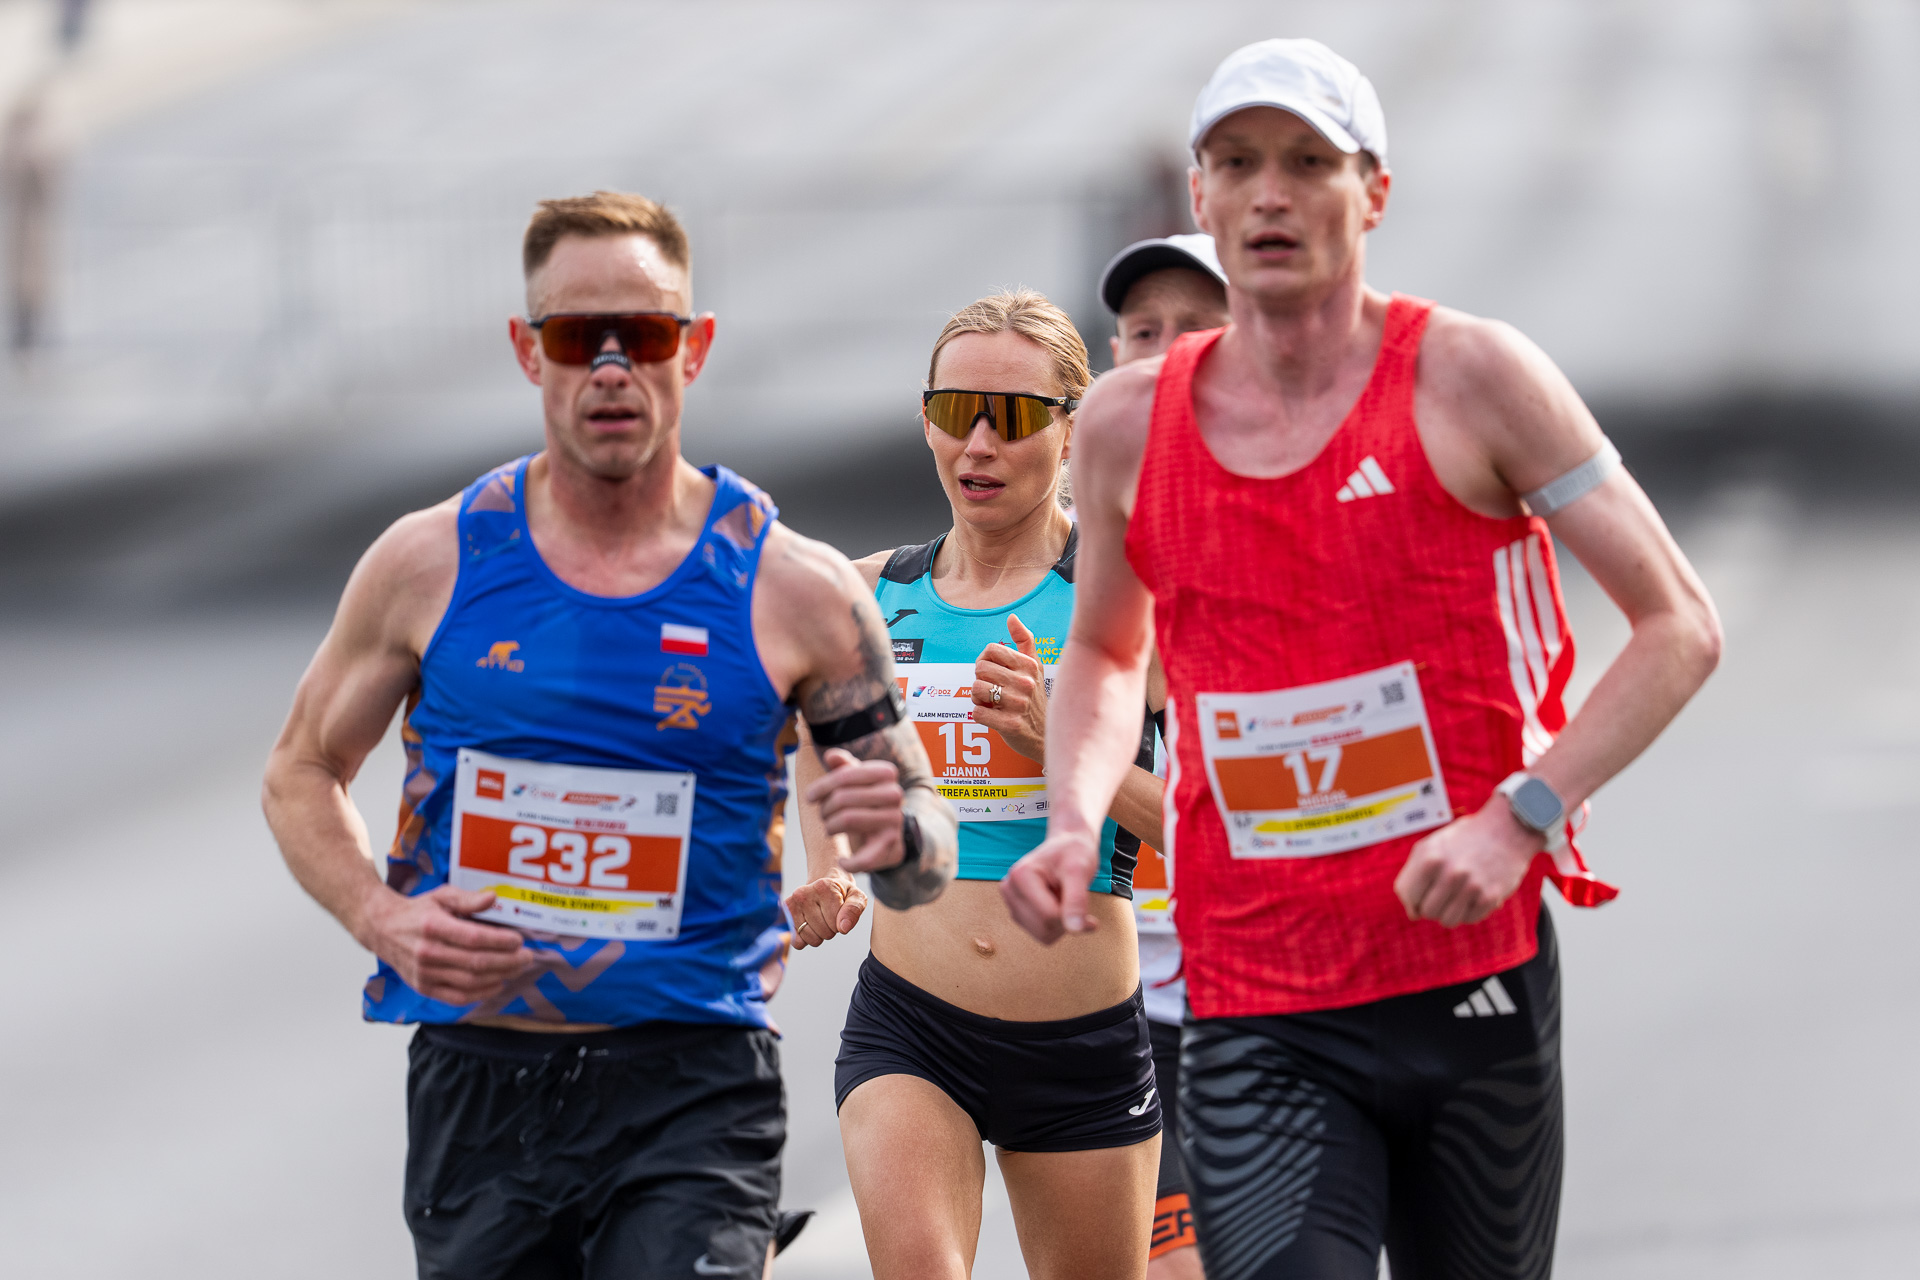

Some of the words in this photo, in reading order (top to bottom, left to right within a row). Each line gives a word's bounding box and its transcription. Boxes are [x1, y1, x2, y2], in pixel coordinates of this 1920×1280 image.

[1035, 637, 1056, 645] UKS
[939, 723, 991, 765] 15
[942, 766, 990, 777] JOANNA
[1283, 746, 1344, 795] 17
[936, 788, 970, 797] STREFA
[972, 788, 1008, 797] STARTU
[507, 825, 632, 889] 232
